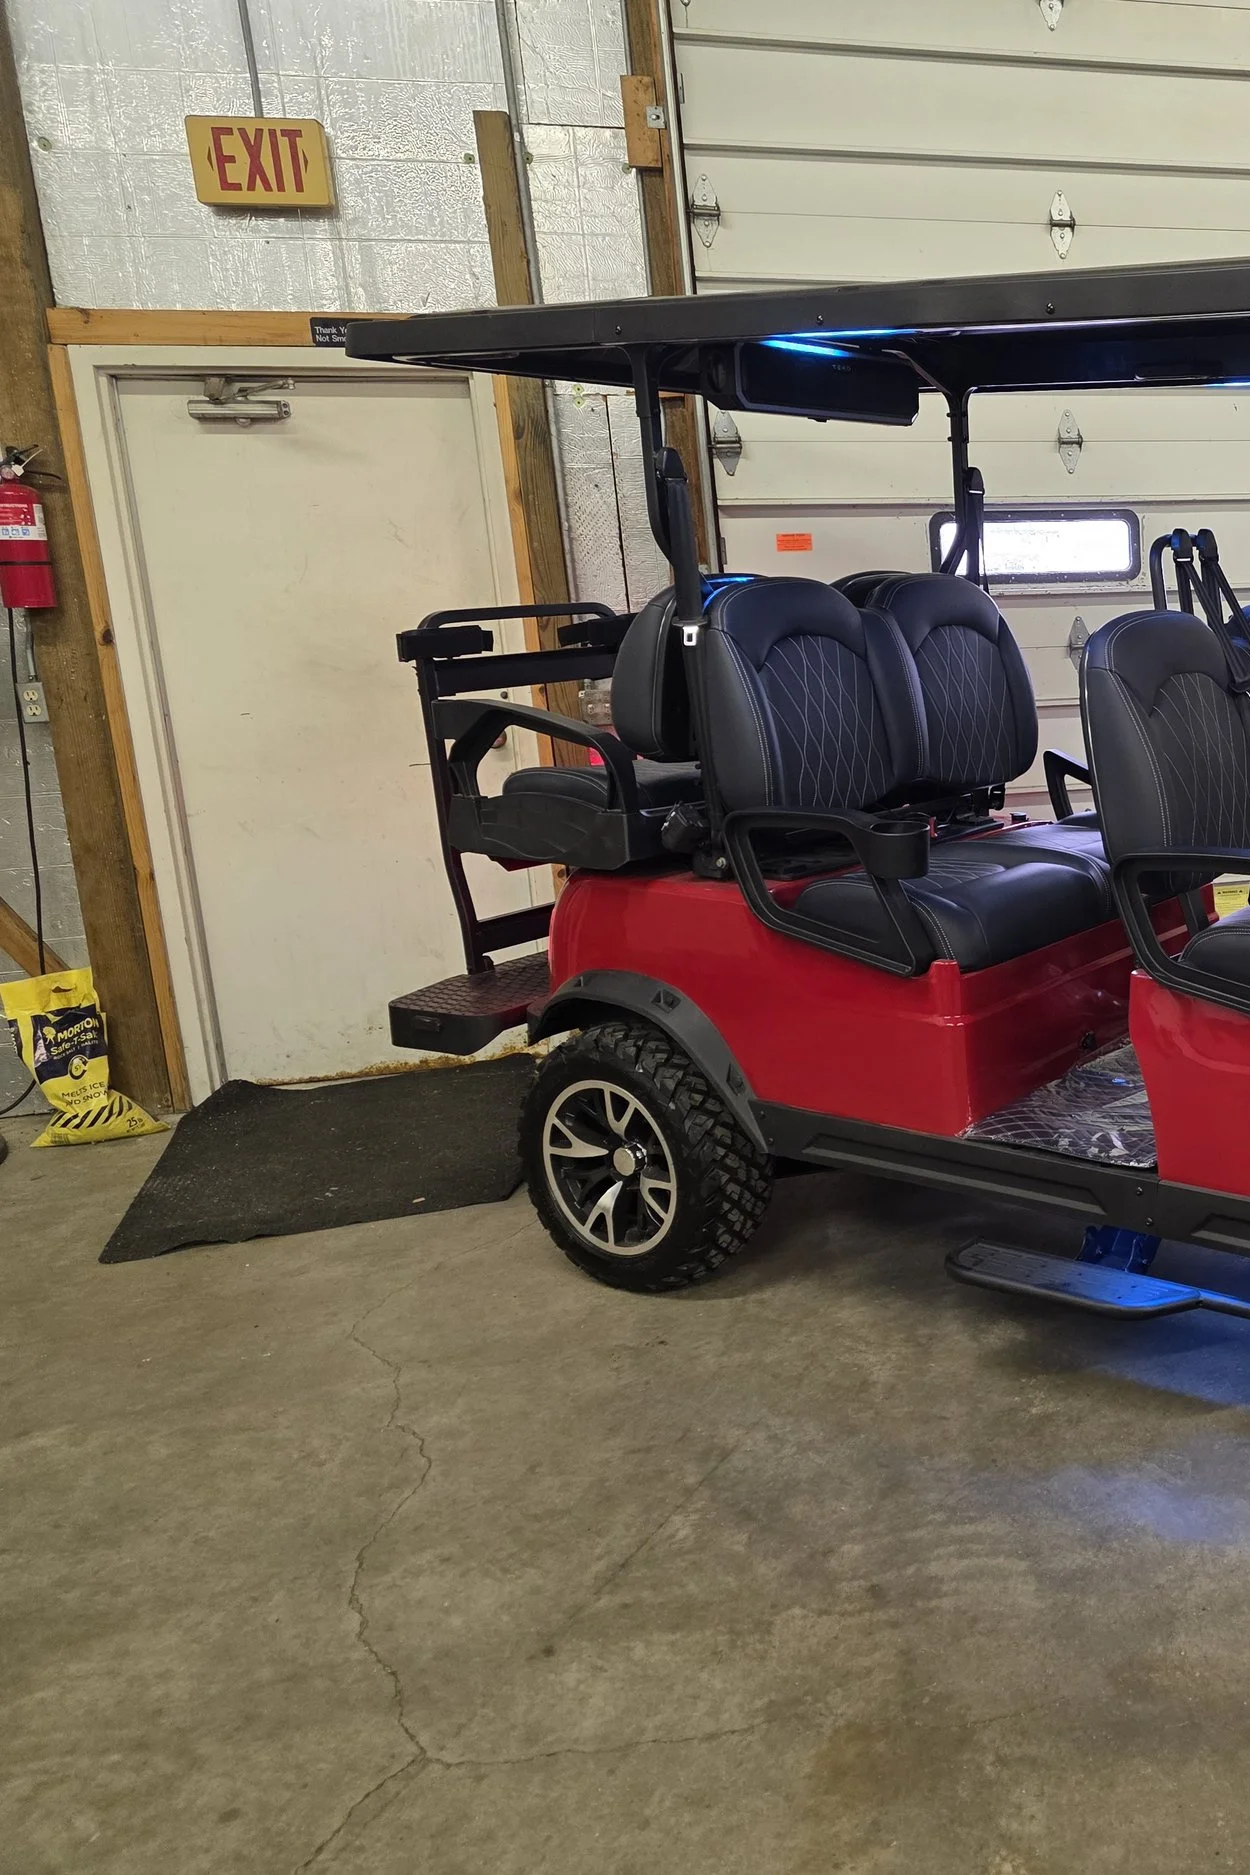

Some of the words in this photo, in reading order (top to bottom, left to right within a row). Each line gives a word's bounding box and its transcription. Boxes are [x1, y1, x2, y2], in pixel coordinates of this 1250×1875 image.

[211, 127, 304, 192] EXIT
[314, 326, 338, 334] Thank
[316, 334, 330, 343] Not
[57, 1017, 99, 1042] MORTON
[61, 1085, 88, 1099] MELTS
[89, 1081, 105, 1090] ICE
[127, 1117, 138, 1128] 25
